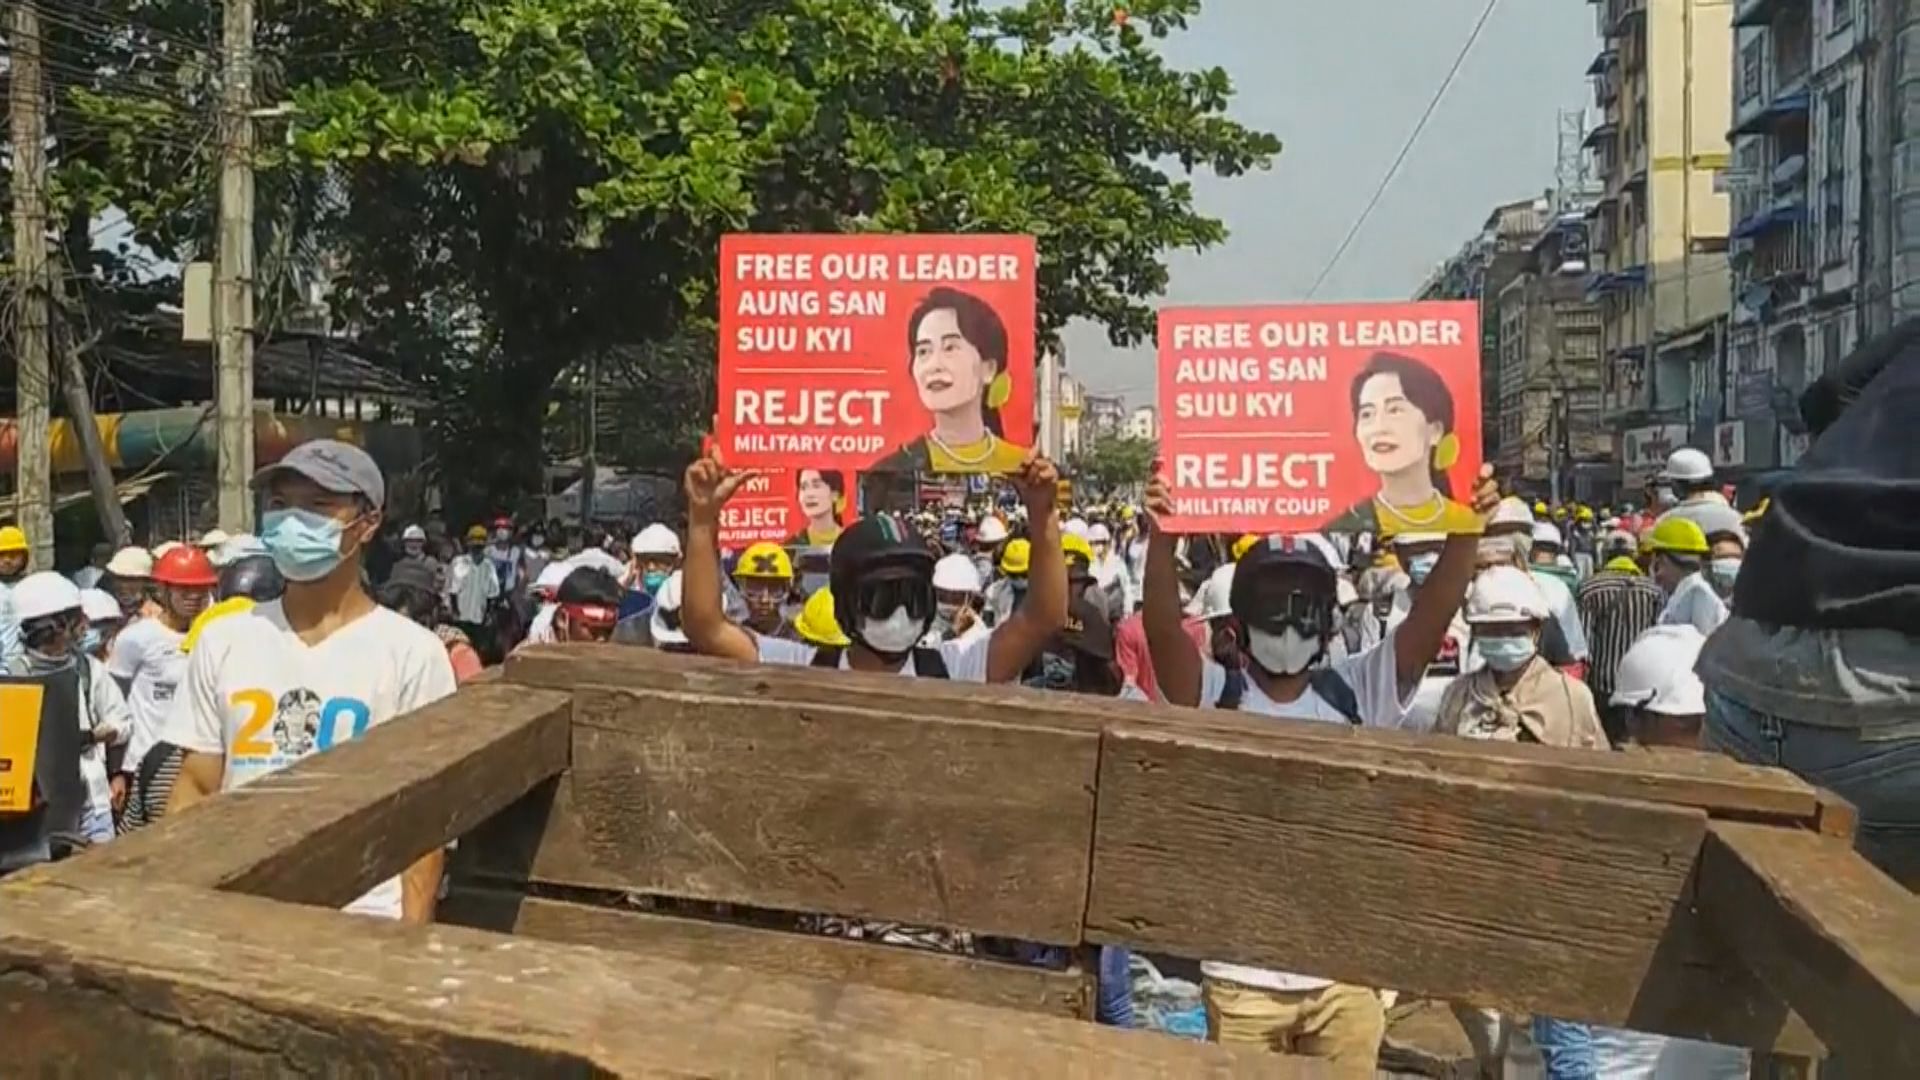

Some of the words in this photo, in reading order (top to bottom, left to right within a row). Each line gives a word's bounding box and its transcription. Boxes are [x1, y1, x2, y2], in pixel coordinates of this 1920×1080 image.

[736, 254, 813, 280] FREE
[821, 253, 889, 280] OUR
[898, 254, 1019, 280] LEADER
[737, 290, 820, 316] AUNG
[828, 290, 886, 316] SAN
[736, 326, 797, 352] SUU
[805, 326, 851, 352] KYI
[1173, 323, 1251, 349] FREE
[1259, 321, 1329, 347] OUR
[1338, 319, 1461, 346] LEADER
[1175, 357, 1260, 383] AUNG
[1268, 355, 1327, 381] SAN
[734, 389, 890, 426] REJECT
[1176, 392, 1237, 418] SUU
[1246, 391, 1293, 417] KYI
[734, 435, 825, 453] MILITARY
[830, 435, 885, 453] COUP
[746, 476, 770, 492] KYI
[1176, 453, 1335, 488] REJECT
[1175, 497, 1269, 515] MILITARY
[1275, 497, 1330, 515] COUP
